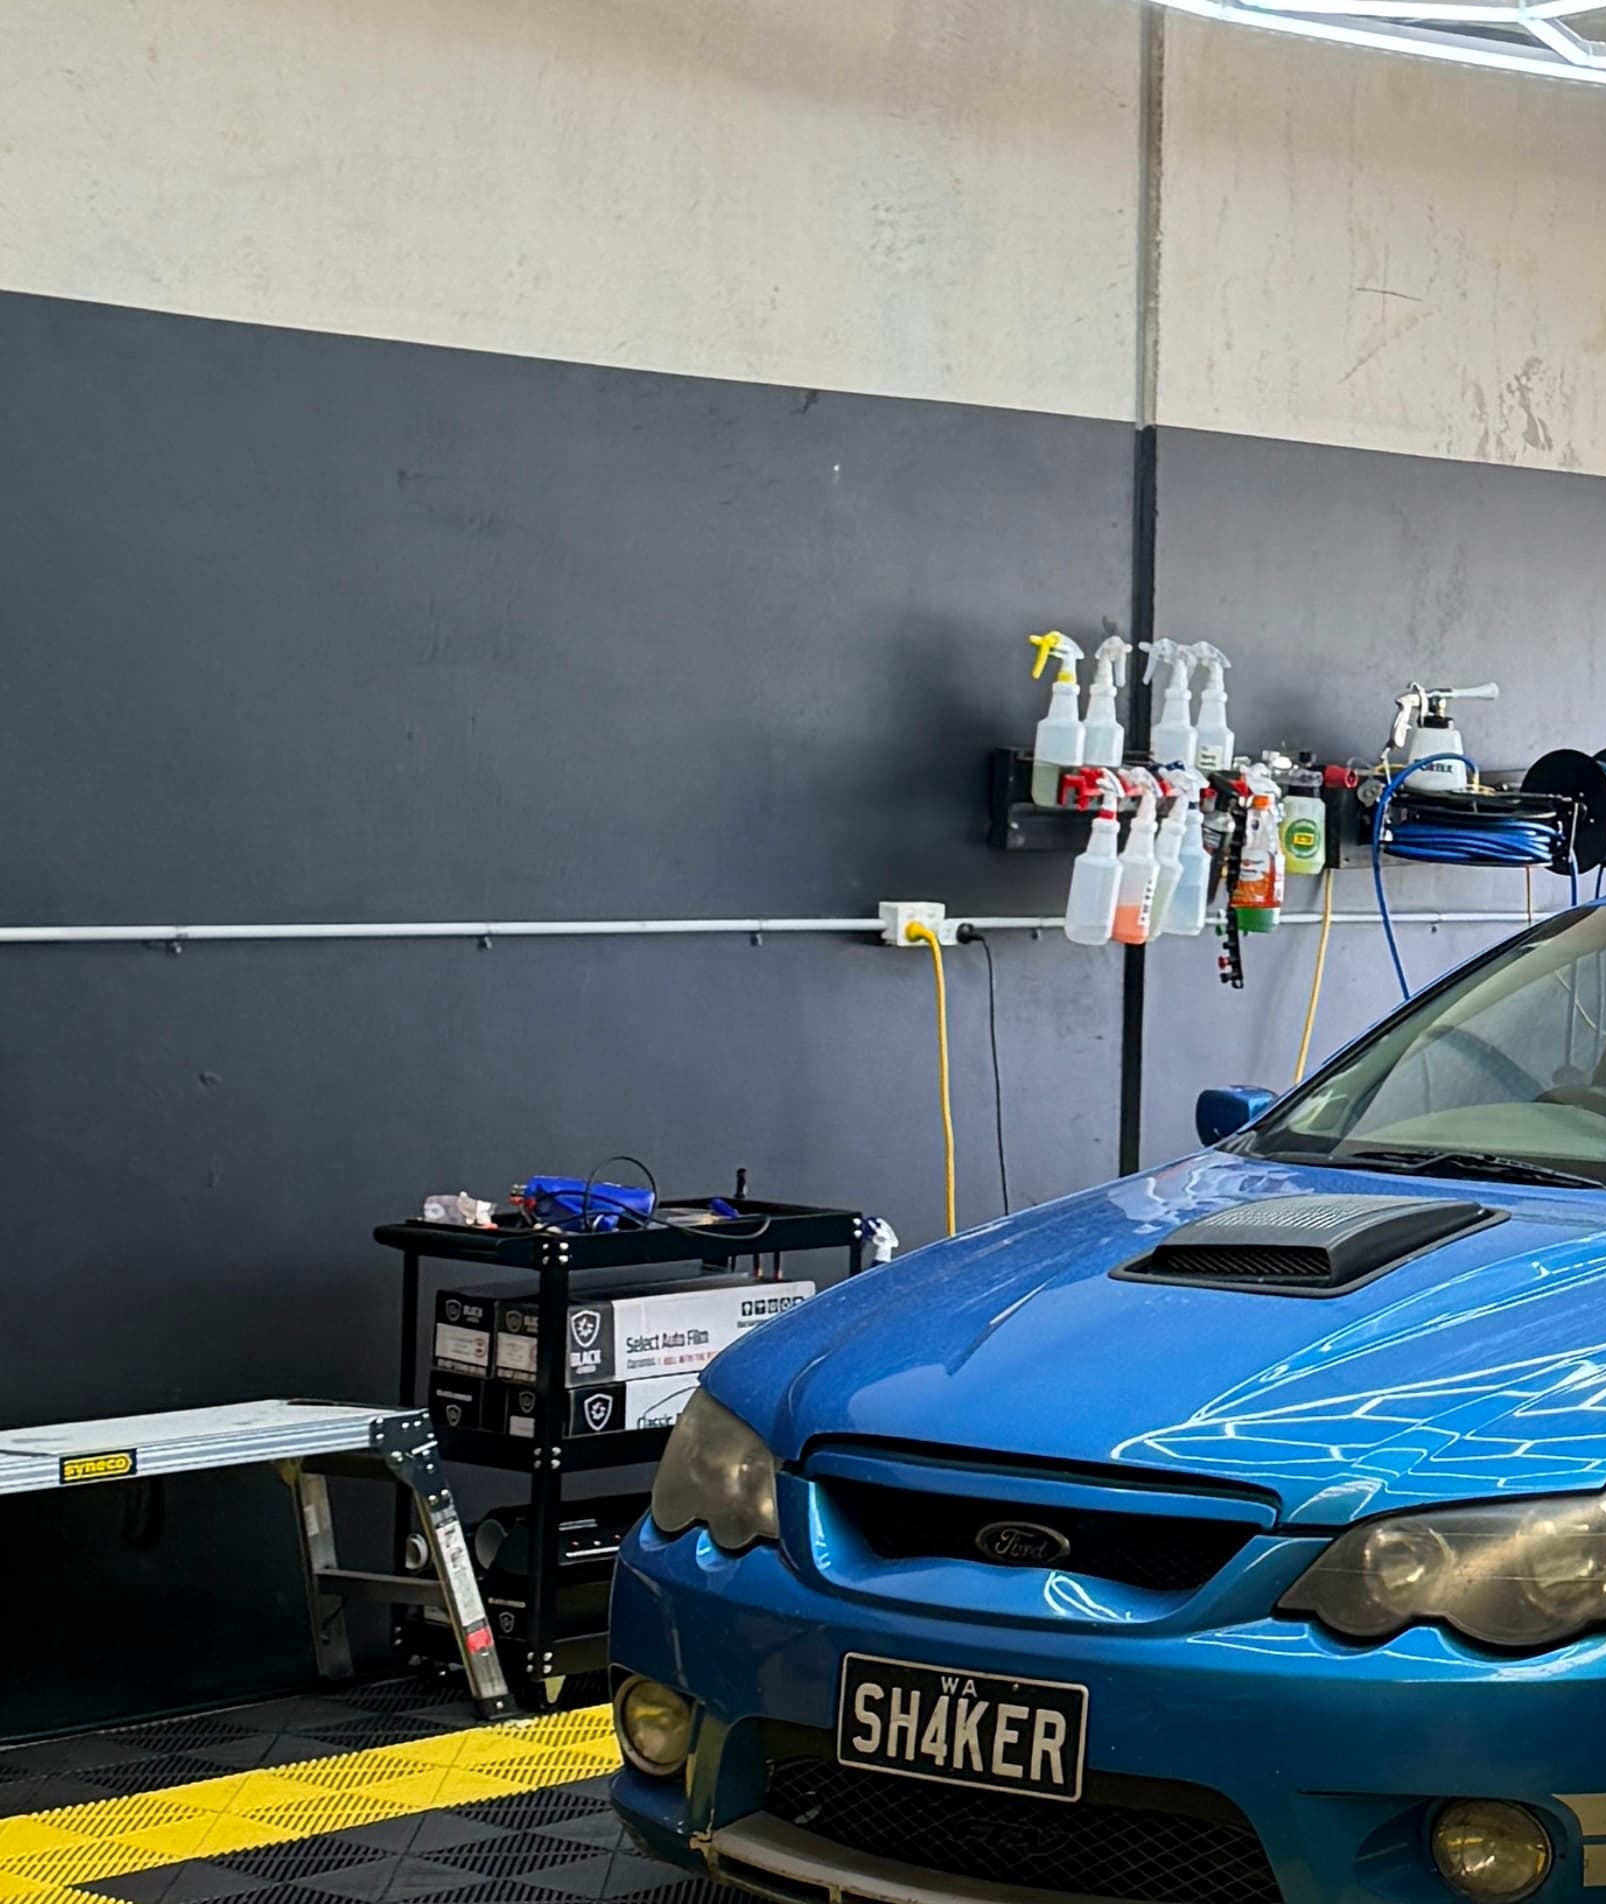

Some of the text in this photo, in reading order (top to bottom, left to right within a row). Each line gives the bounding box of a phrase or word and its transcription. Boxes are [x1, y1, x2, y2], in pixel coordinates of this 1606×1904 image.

[626, 1329, 709, 1353] Select Auto Film
[570, 1350, 601, 1367] BLACK
[64, 1459, 126, 1476] syneco
[995, 1528, 1048, 1557] Ford
[940, 1675, 978, 1698] WA
[852, 1683, 1066, 1784] SH4KER
